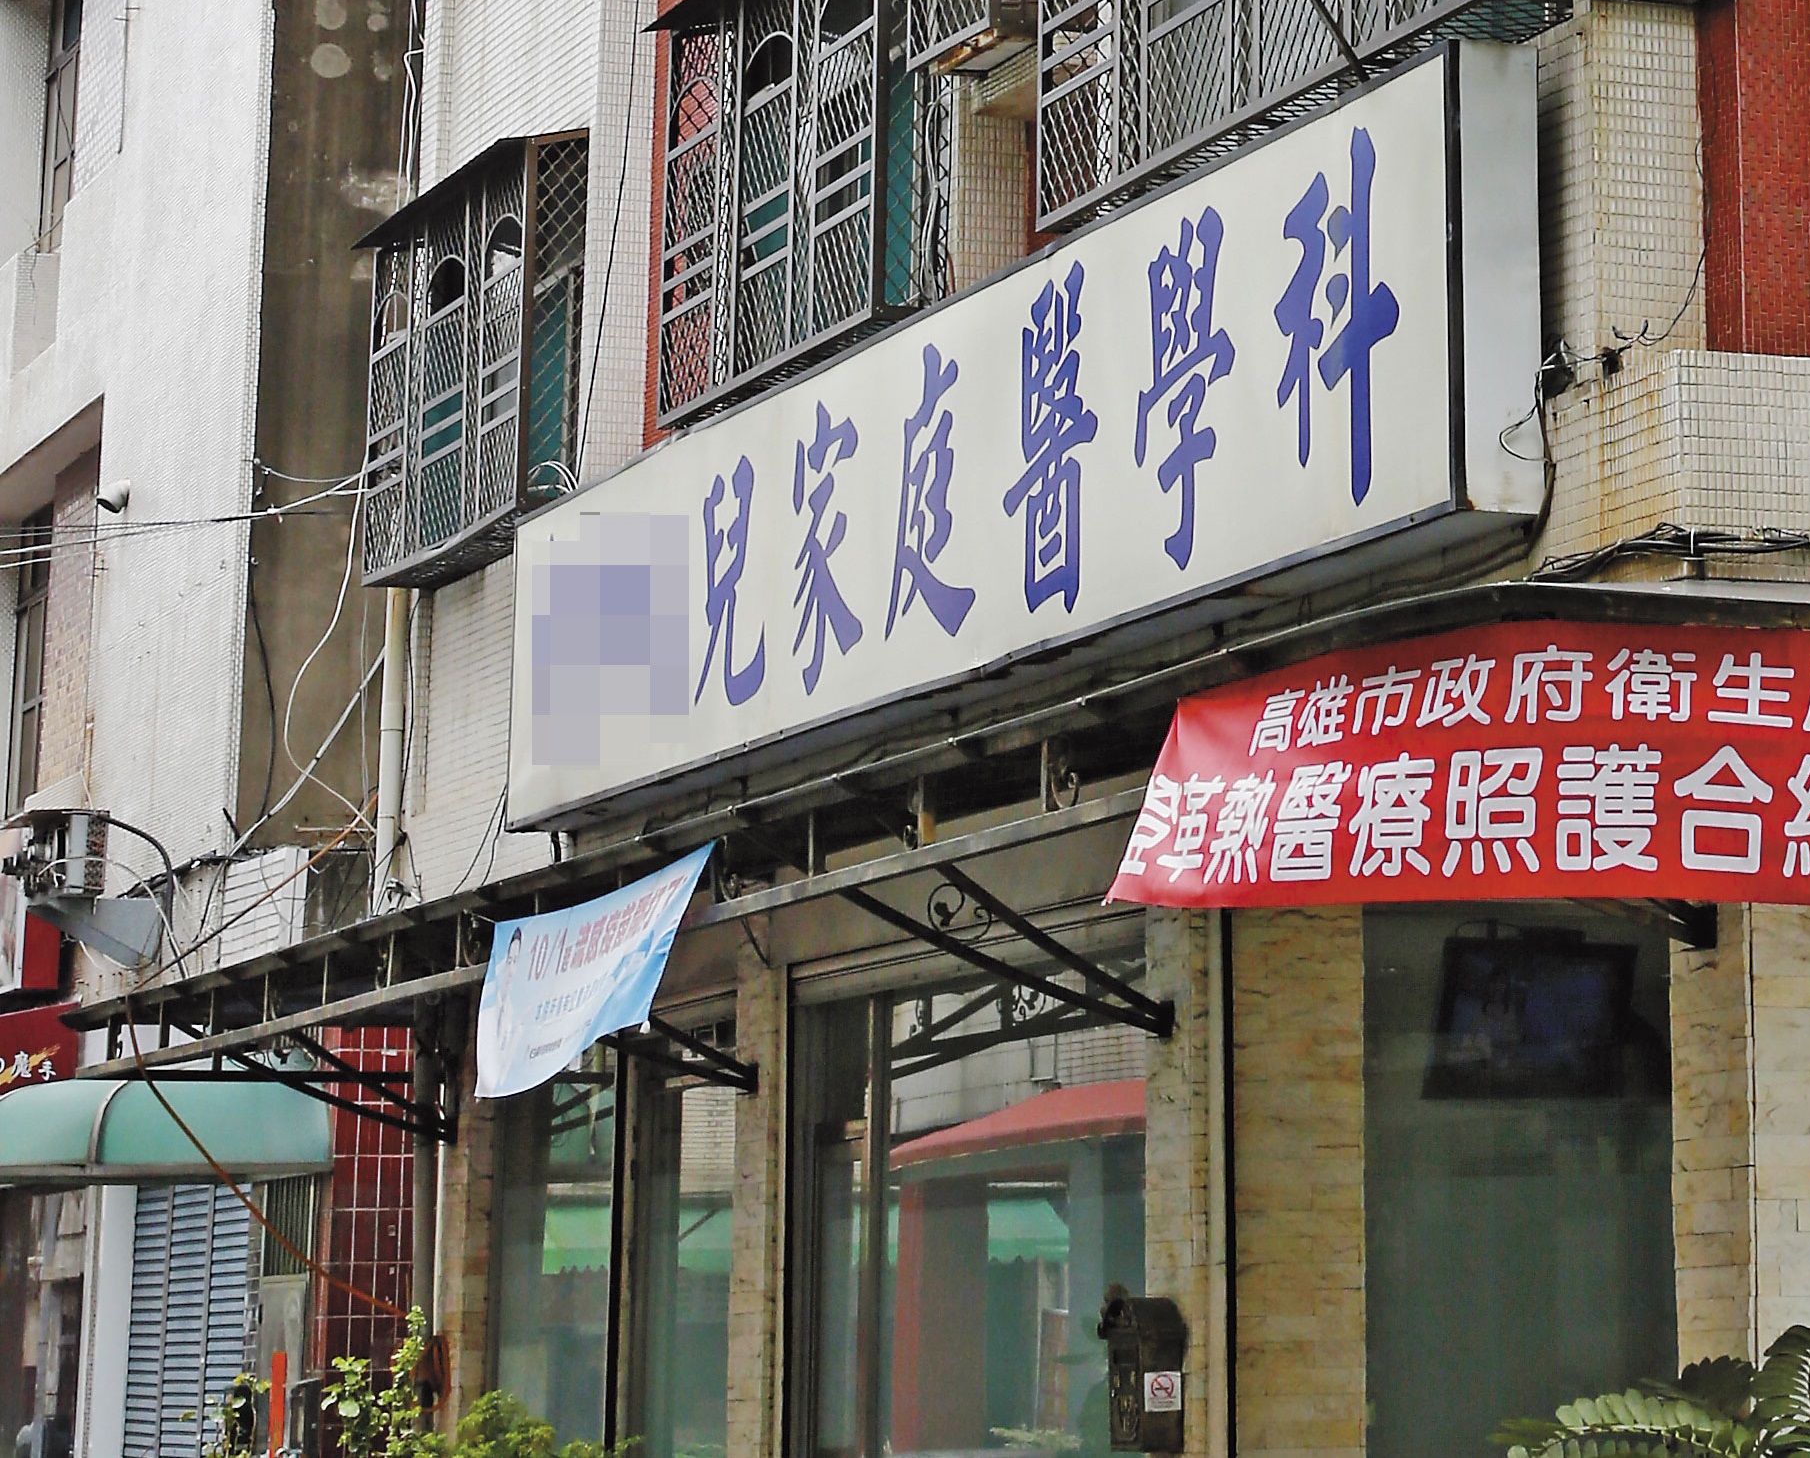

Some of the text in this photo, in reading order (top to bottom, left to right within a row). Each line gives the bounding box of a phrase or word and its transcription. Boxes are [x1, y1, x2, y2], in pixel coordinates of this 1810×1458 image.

[694, 126, 1400, 708] 兒家庭醫學科
